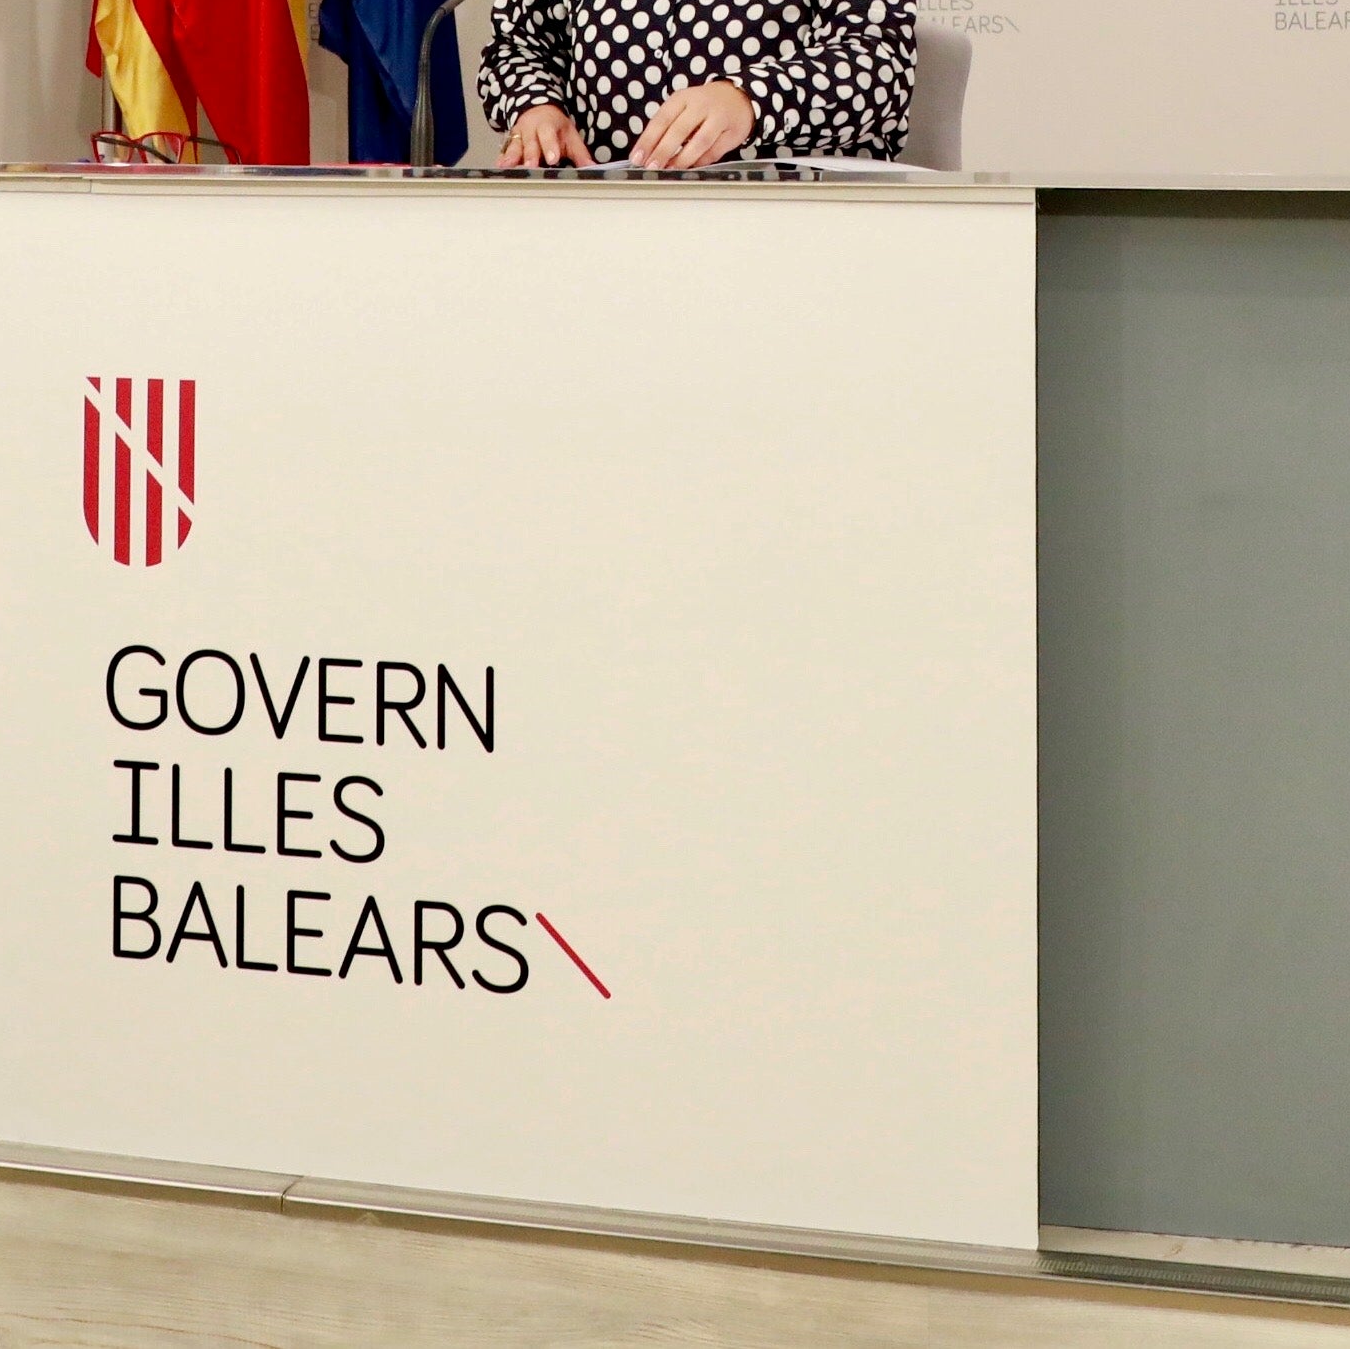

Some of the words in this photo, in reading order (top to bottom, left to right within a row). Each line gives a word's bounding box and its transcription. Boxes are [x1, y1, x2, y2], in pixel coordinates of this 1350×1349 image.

[106, 645, 495, 753] GOVERN
[112, 759, 386, 864] ILLES
[113, 874, 530, 994] BALEARS
